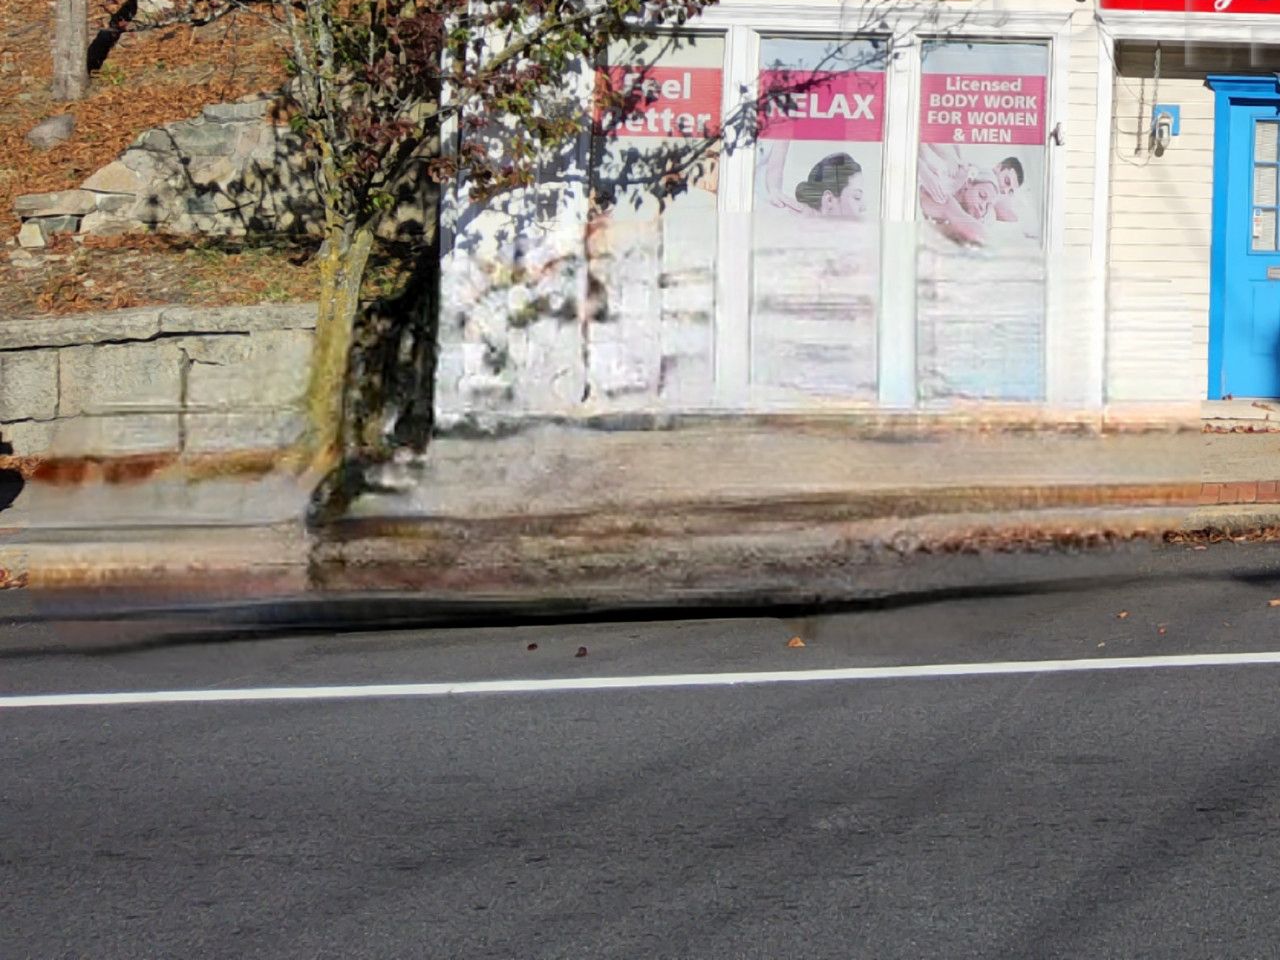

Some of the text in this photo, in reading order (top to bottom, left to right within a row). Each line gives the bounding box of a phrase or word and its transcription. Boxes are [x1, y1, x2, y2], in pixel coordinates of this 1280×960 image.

[946, 76, 1021, 92] Licensed
[930, 95, 1037, 110] BODY WORK
[928, 111, 1038, 126] FOR WOMEN
[953, 128, 1011, 143] & MEN
